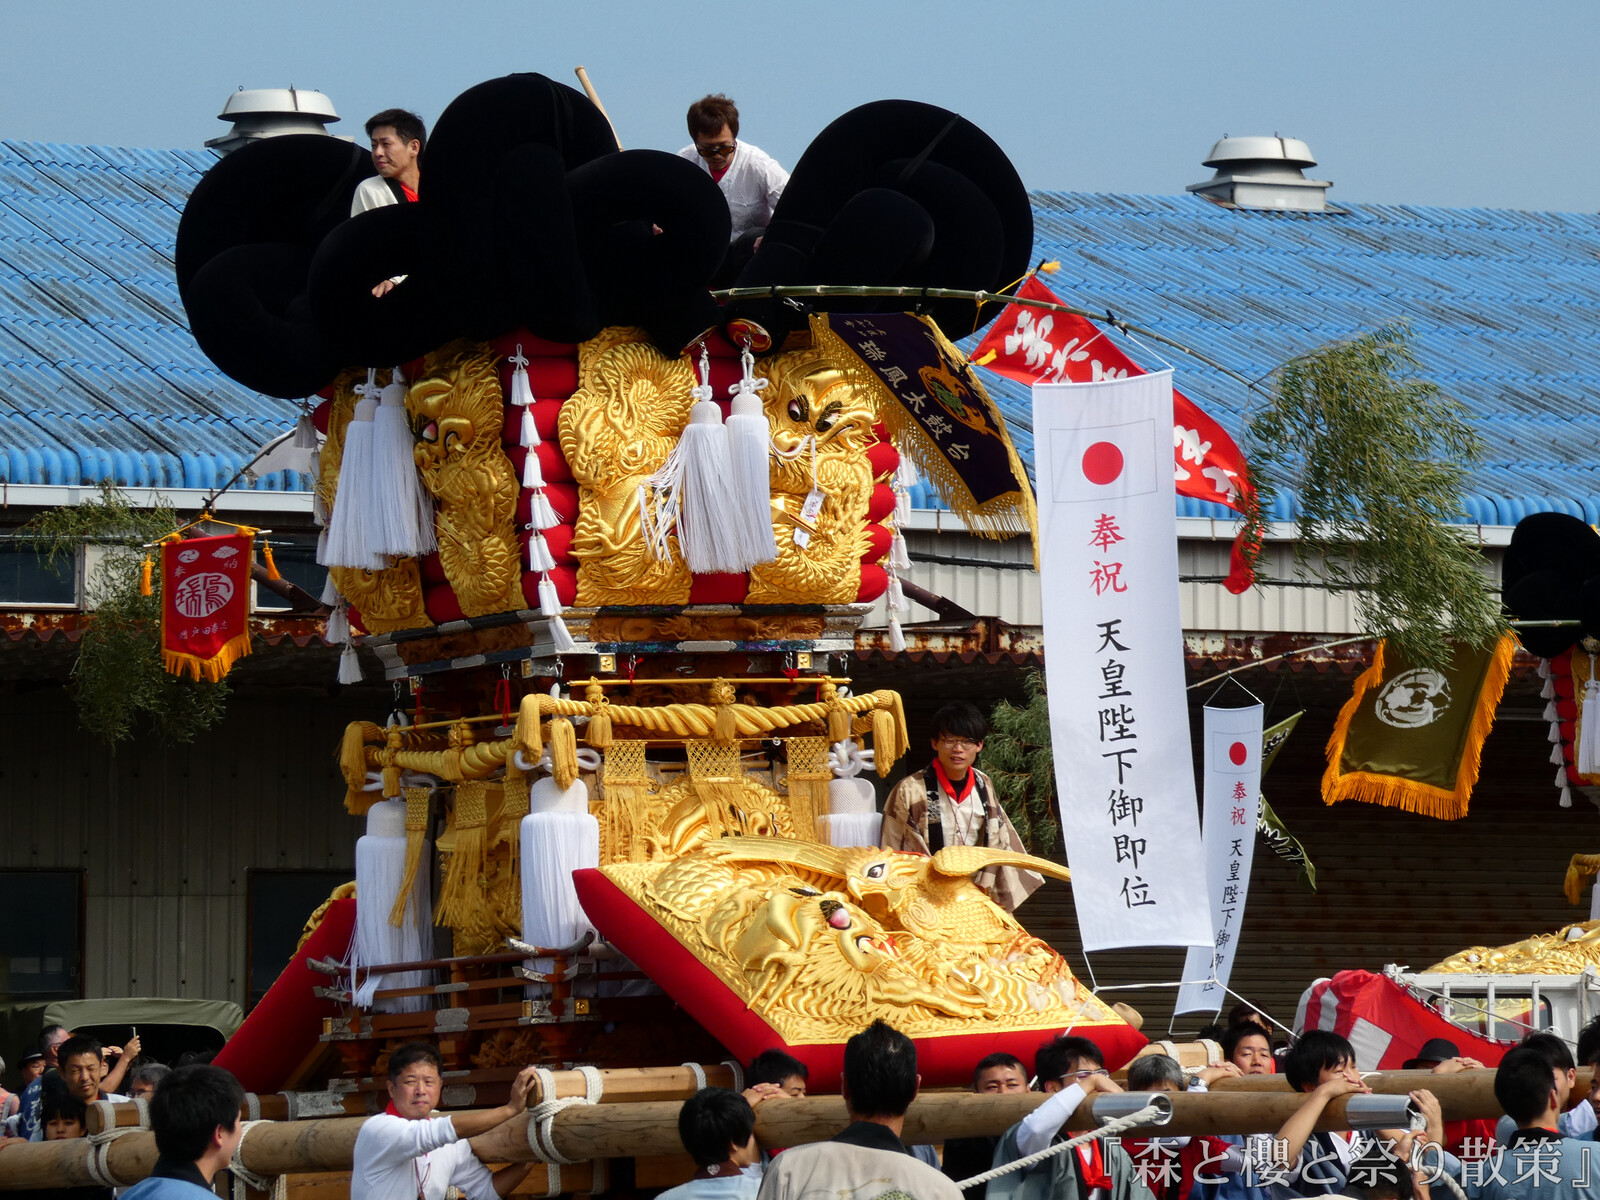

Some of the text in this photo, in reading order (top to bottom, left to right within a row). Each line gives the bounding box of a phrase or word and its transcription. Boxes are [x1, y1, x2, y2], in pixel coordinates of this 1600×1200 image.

[1087, 512, 1157, 910] 奉祝 天皇陛下御即位
[1230, 781, 1248, 827] 奉祝
